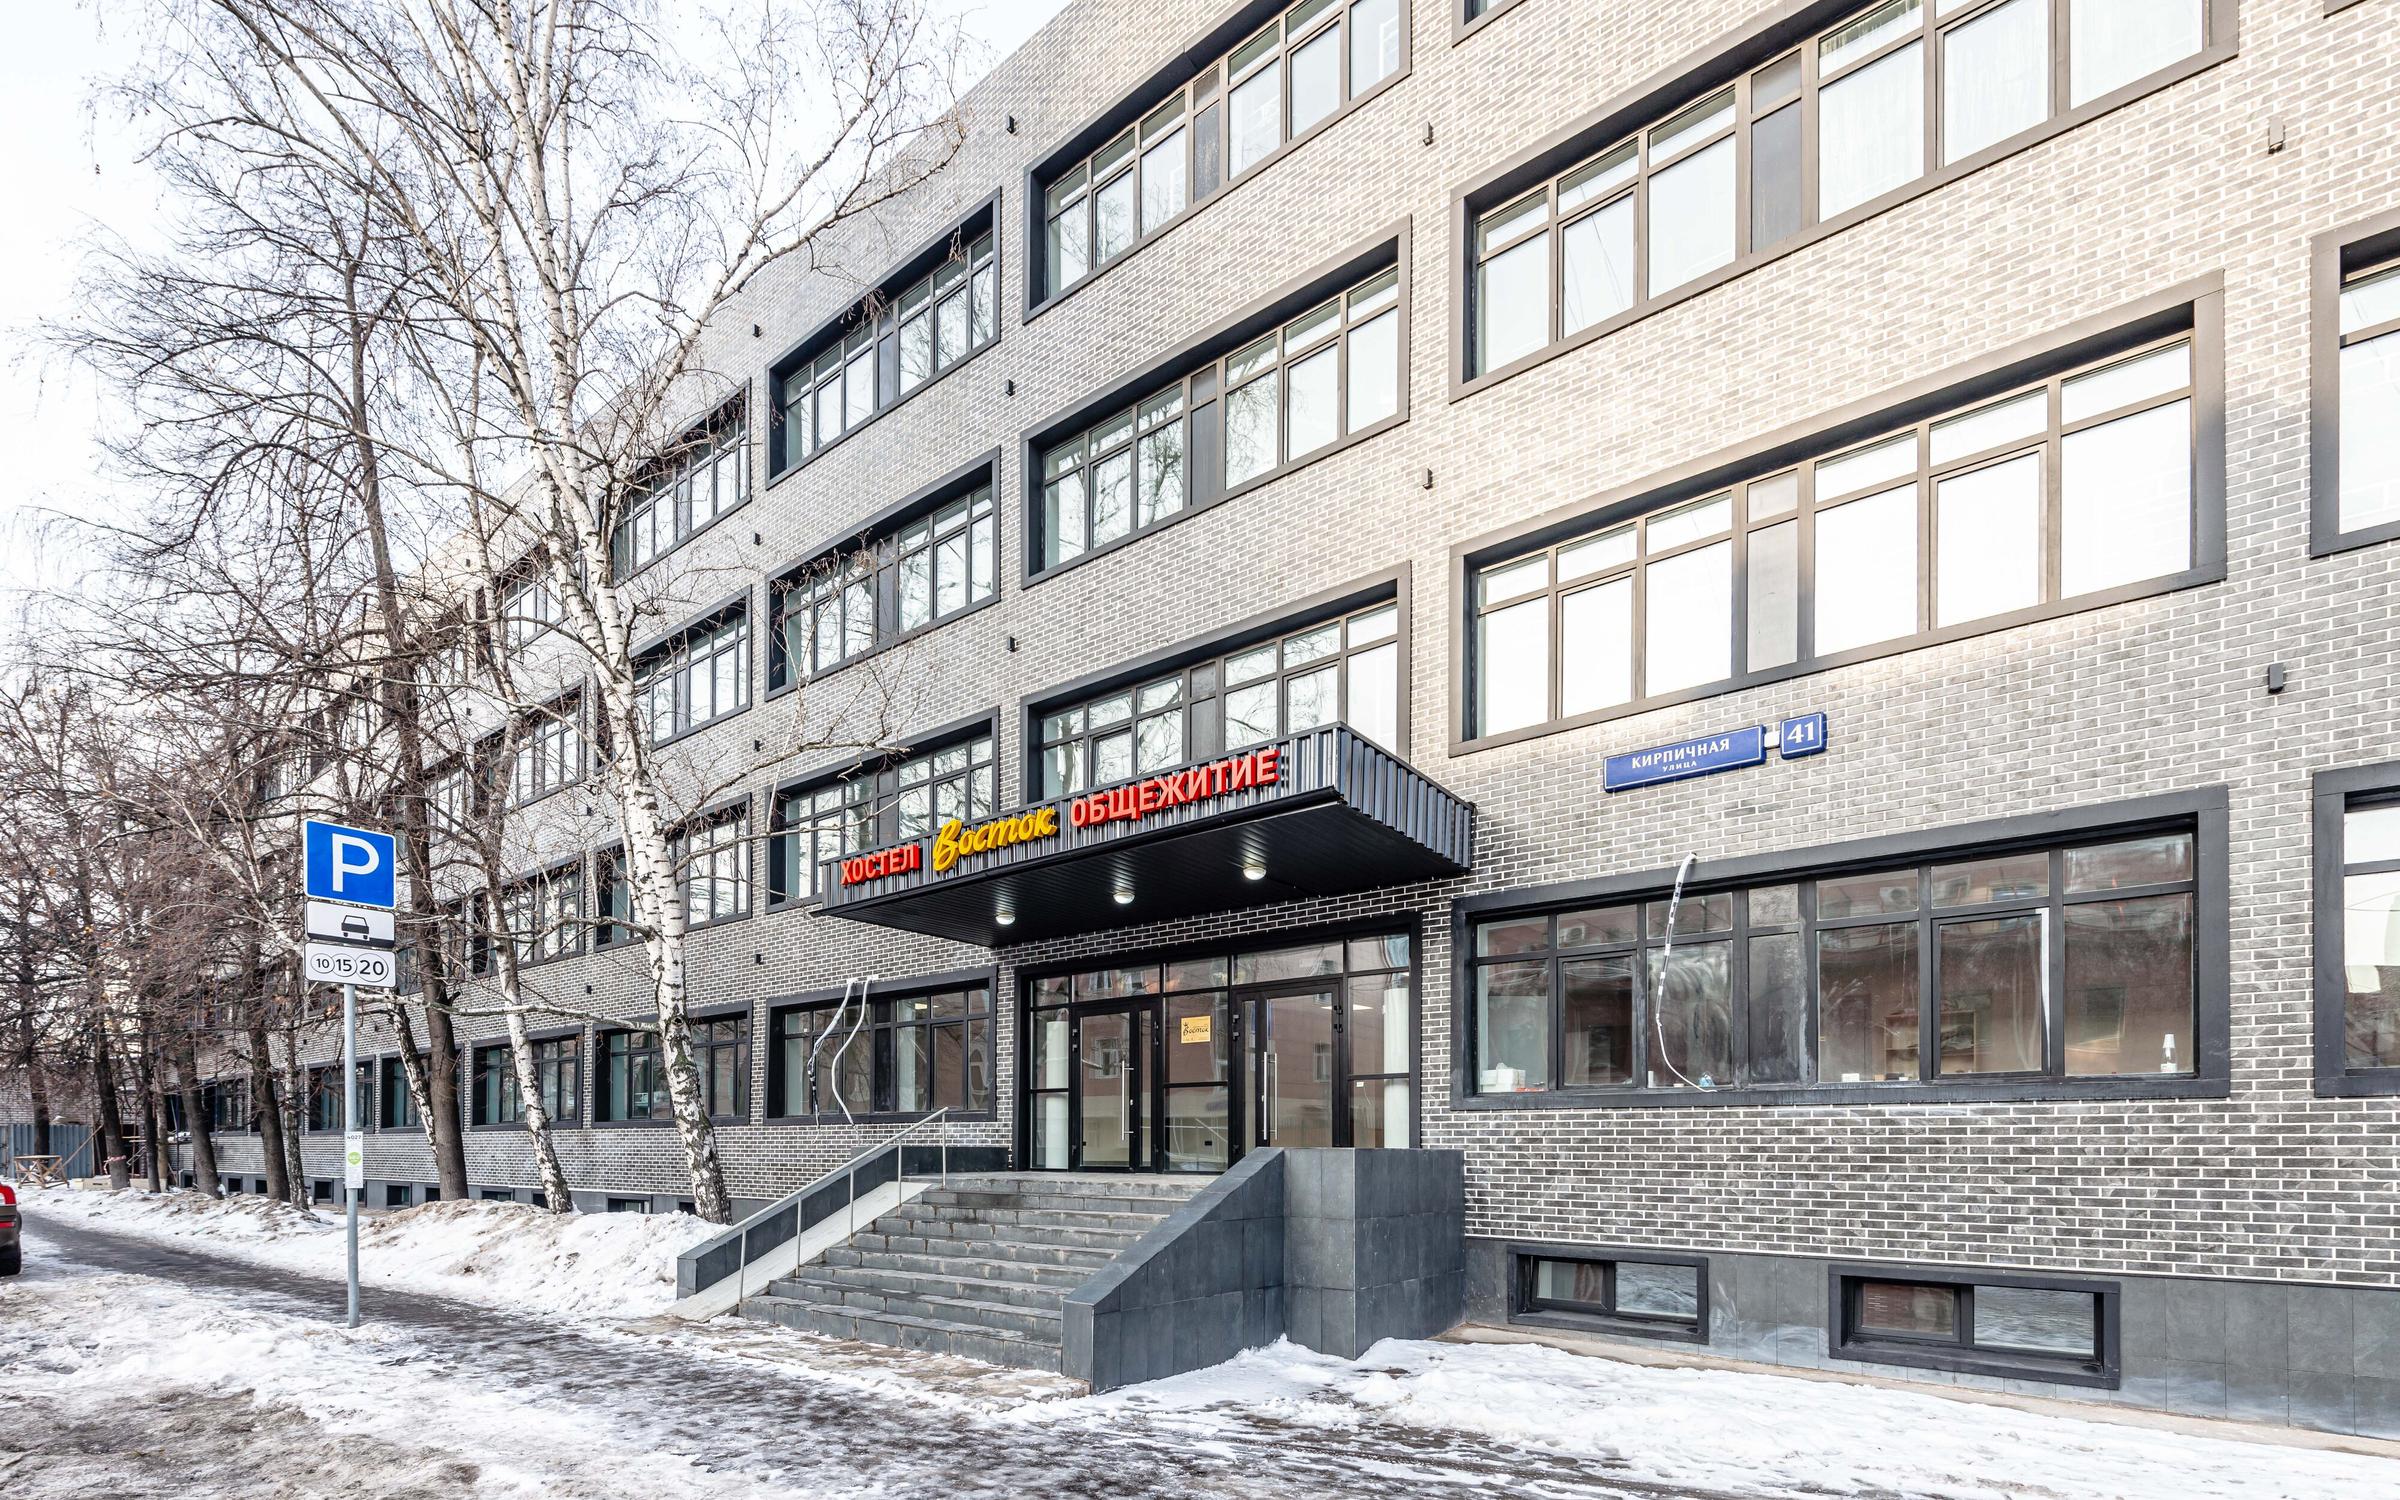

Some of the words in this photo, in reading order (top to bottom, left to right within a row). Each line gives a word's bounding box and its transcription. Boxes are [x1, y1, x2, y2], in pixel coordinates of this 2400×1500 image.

[1787, 721, 1815, 744] 41
[1631, 738, 1730, 769] КИРПИЧНАЯ
[1662, 761, 1697, 772] УЛИЦА
[840, 845, 920, 885] ХОСТЕЛ
[933, 808, 1058, 872] Восток
[1070, 749, 1280, 828] ОБЩЕЖИТИЕ
[332, 833, 380, 892] P
[315, 958, 330, 969] 10
[335, 958, 353, 972] 15
[359, 959, 385, 976] 20
